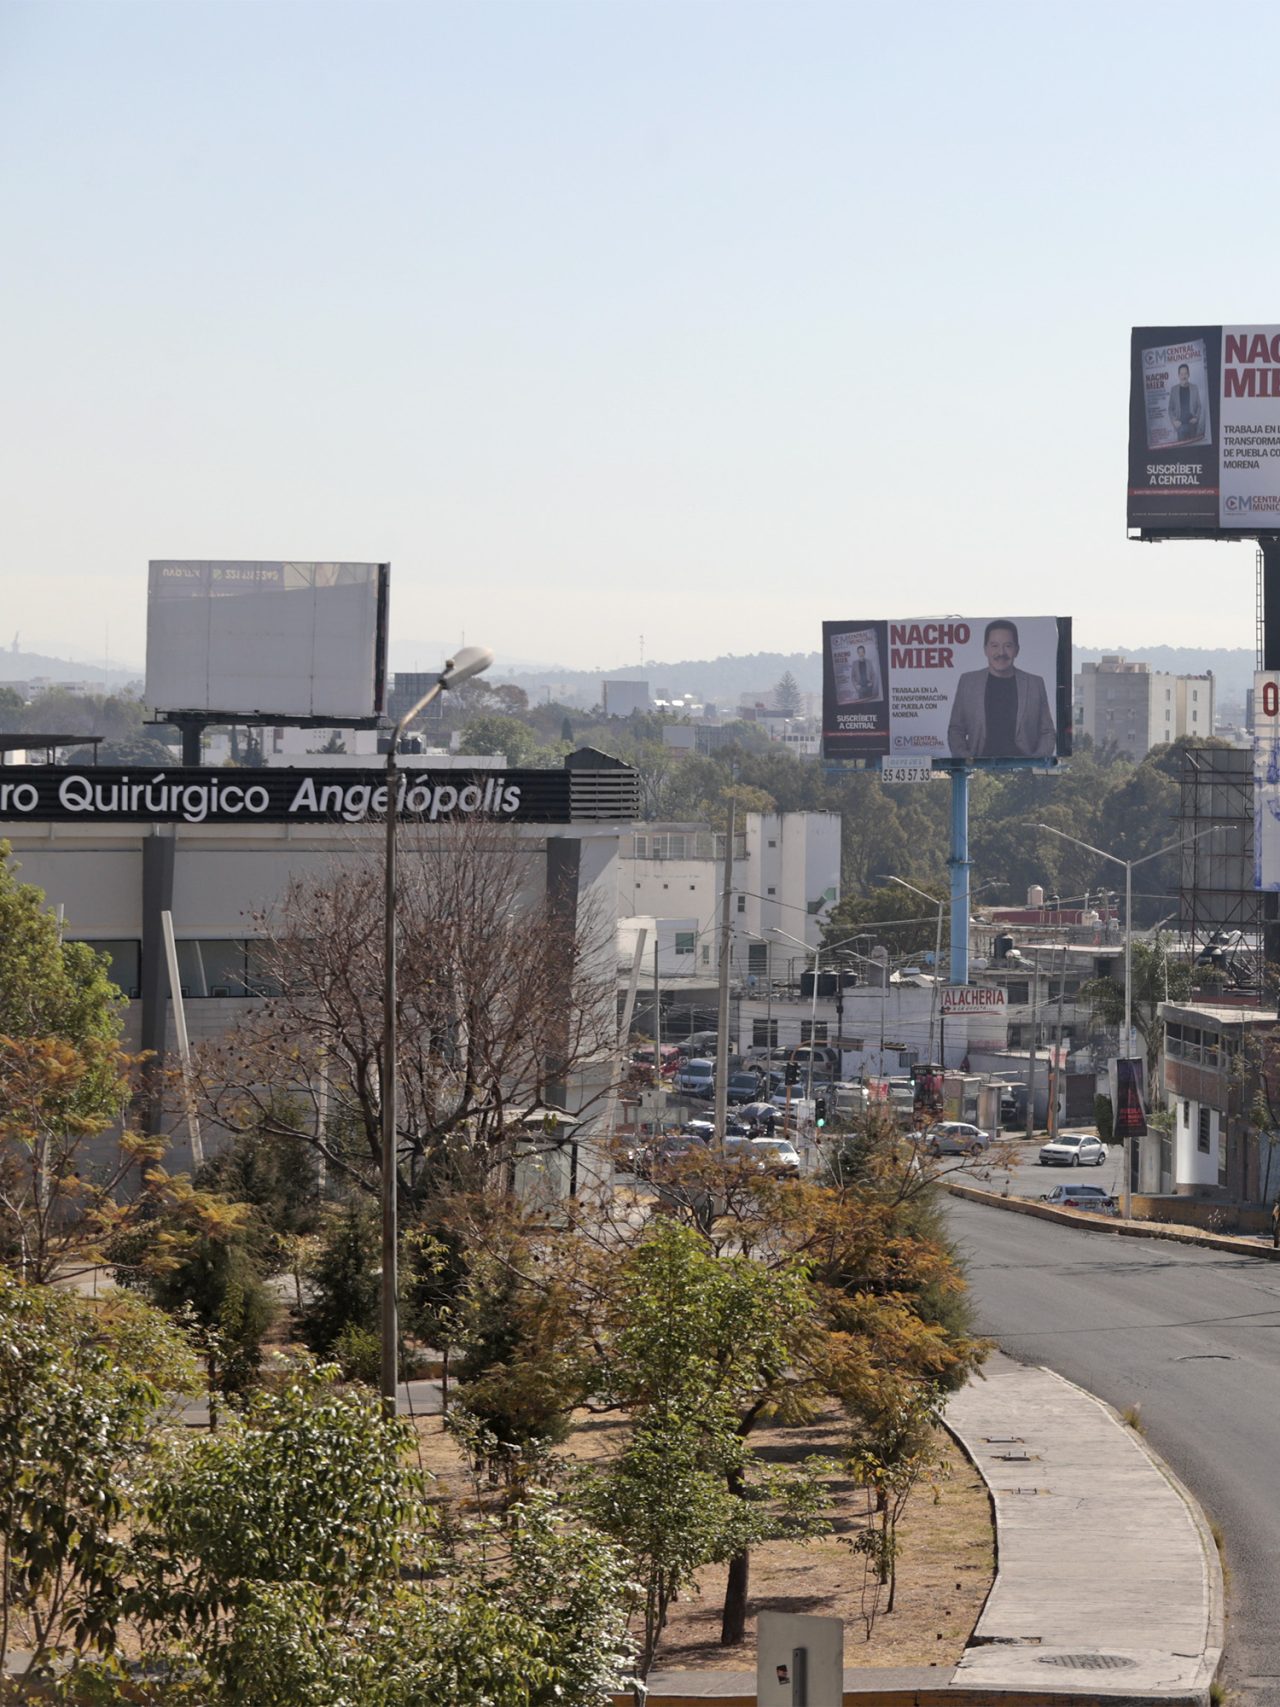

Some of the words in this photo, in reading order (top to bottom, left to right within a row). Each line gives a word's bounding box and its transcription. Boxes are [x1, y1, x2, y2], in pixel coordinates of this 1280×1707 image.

[1224, 425, 1263, 434] TRABAJA
[1265, 425, 1276, 434] EN
[1224, 449, 1234, 457] DE
[1236, 449, 1268, 457] PUEBLA
[1146, 462, 1202, 474] SUSCRÍBETE
[1224, 461, 1260, 469] MORENA
[1149, 475, 1157, 485] A
[1158, 475, 1200, 485] CENTRAL
[890, 623, 970, 645] NACHO
[891, 647, 954, 669] MIER
[836, 712, 877, 722] SUSCRÍBETE
[884, 769, 893, 781] 55
[895, 769, 905, 781] 43
[908, 769, 917, 781] 57
[920, 769, 929, 781] 33
[58, 773, 270, 822] Quirúrgico
[288, 774, 521, 822] Angelópolis
